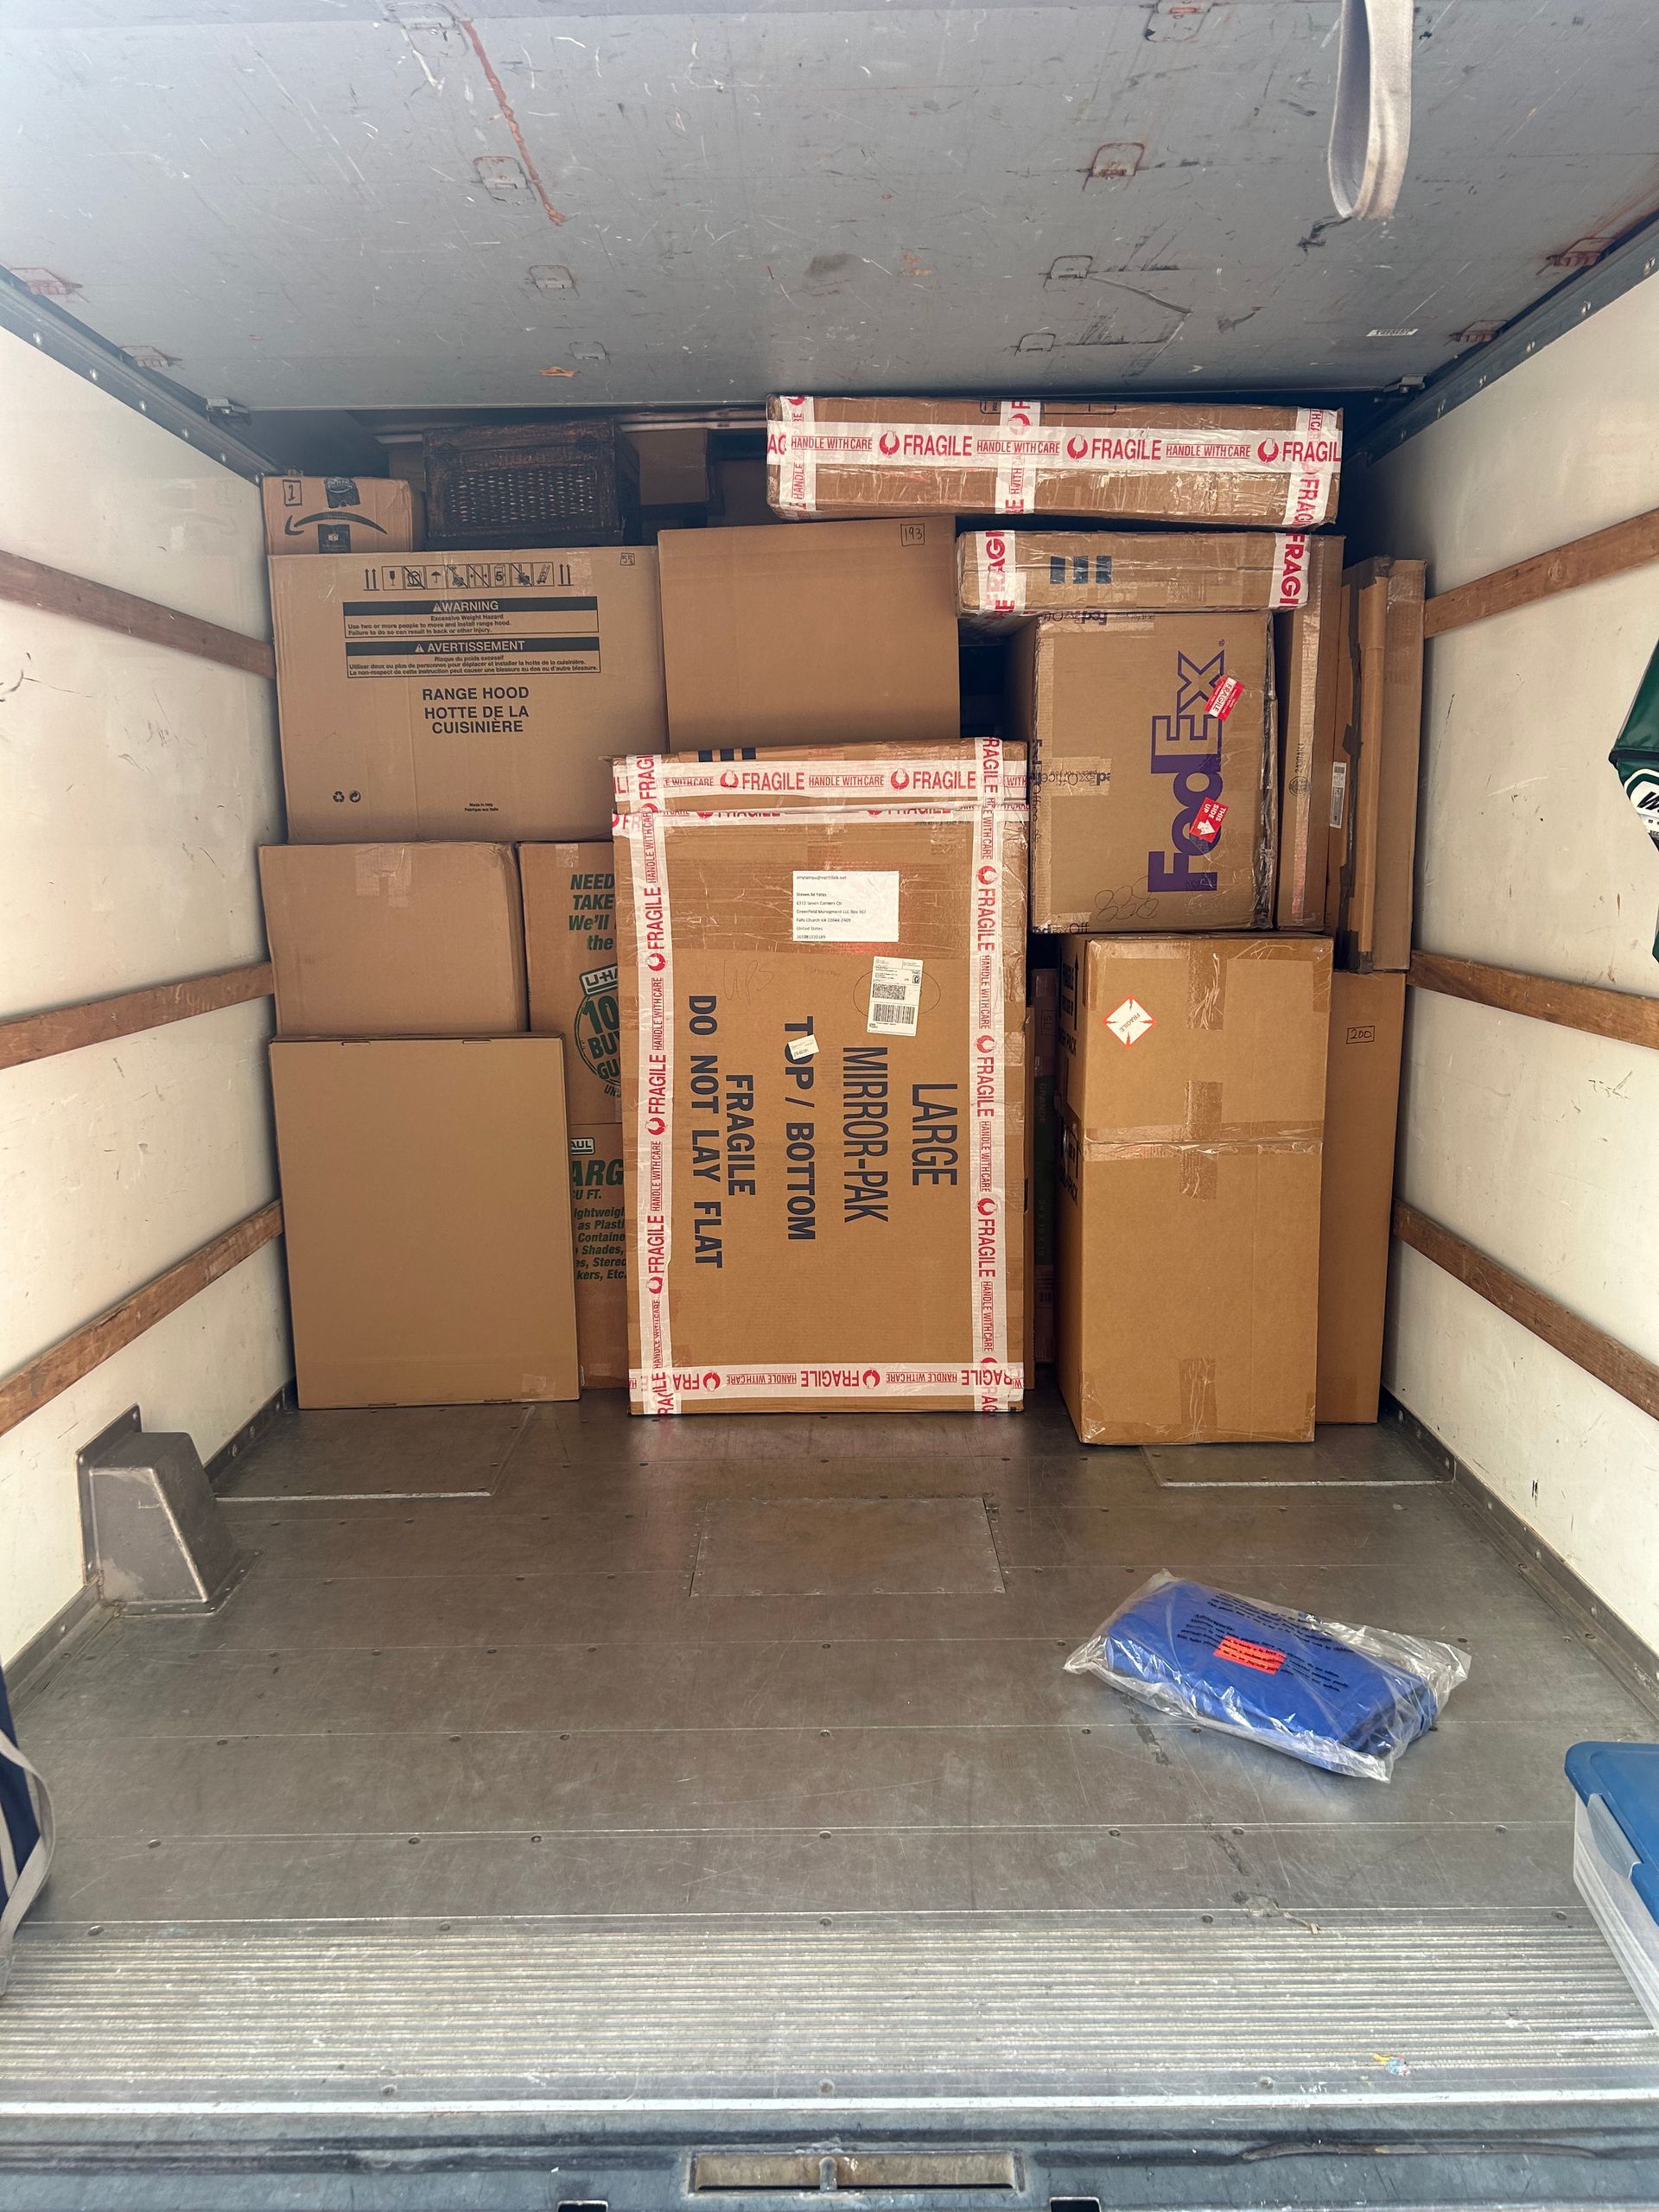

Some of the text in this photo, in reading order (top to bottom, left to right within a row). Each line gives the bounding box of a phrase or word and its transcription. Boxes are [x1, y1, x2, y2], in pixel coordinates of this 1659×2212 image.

[791, 438, 823, 449] HANDLE
[827, 439, 851, 449] WITH
[852, 439, 873, 450] CARE
[904, 435, 972, 456] FRAGILE
[977, 441, 1012, 453] HANDLE
[1014, 442, 1037, 453] WITH
[1038, 442, 1060, 454] CARE
[1092, 439, 1162, 461] FRAGILE
[1166, 445, 1202, 456] HANDLE
[1204, 446, 1228, 457] WITH
[1229, 447, 1251, 458] CARE
[905, 527, 923, 543] 193
[442, 601, 499, 612] WARNING
[427, 641, 525, 652] AVERTISSEMENT
[423, 687, 530, 701] RANGE HOOD
[1212, 683, 1232, 712] FRAGILE
[424, 705, 530, 719] HOTTE DE LA
[432, 718, 524, 734] CUISINIÈRE
[1147, 650, 1224, 893] FedEx
[694, 771, 976, 791] CARE FRAGILE HANDLE WITH CARE FRAGILE
[1204, 804, 1211, 813] UP
[1209, 804, 1219, 818] SIDE
[1216, 808, 1226, 822] THIS
[645, 834, 656, 854] WITH
[646, 855, 658, 883] HANDLE
[570, 874, 615, 890] NEED
[573, 894, 615, 911] TAKE
[569, 915, 609, 931] We'll
[588, 935, 613, 950] the
[644, 887, 666, 1051] FRAGILE HANDLE WITH CARE
[1119, 1013, 1141, 1033] FRAGILE
[1350, 1029, 1372, 1039] 200
[977, 817, 995, 1352] WITH CARE FRAGILE HANDLE WITH CARE FRAGILE HANDLE WITH CARE FRAGILE HANDLE WITH CARE
[649, 1054, 666, 1211] FRAGILE HANDLE WITH CARE
[689, 995, 723, 1268] DO NOT LAY FLAT
[726, 1074, 756, 1196] FRAGILE
[842, 1046, 889, 1224] MIRROR-PAK
[912, 1084, 958, 1186] LARGE
[785, 1122, 816, 1240] BOTTOM
[587, 1189, 601, 1199] FT.
[578, 1221, 590, 1230] as
[582, 1244, 624, 1255] Shades,
[647, 1216, 664, 1273] FRAGILE
[727, 1370, 957, 1388] HANDLE WITH CARE FRAGILE HANDLE WITH CARE
